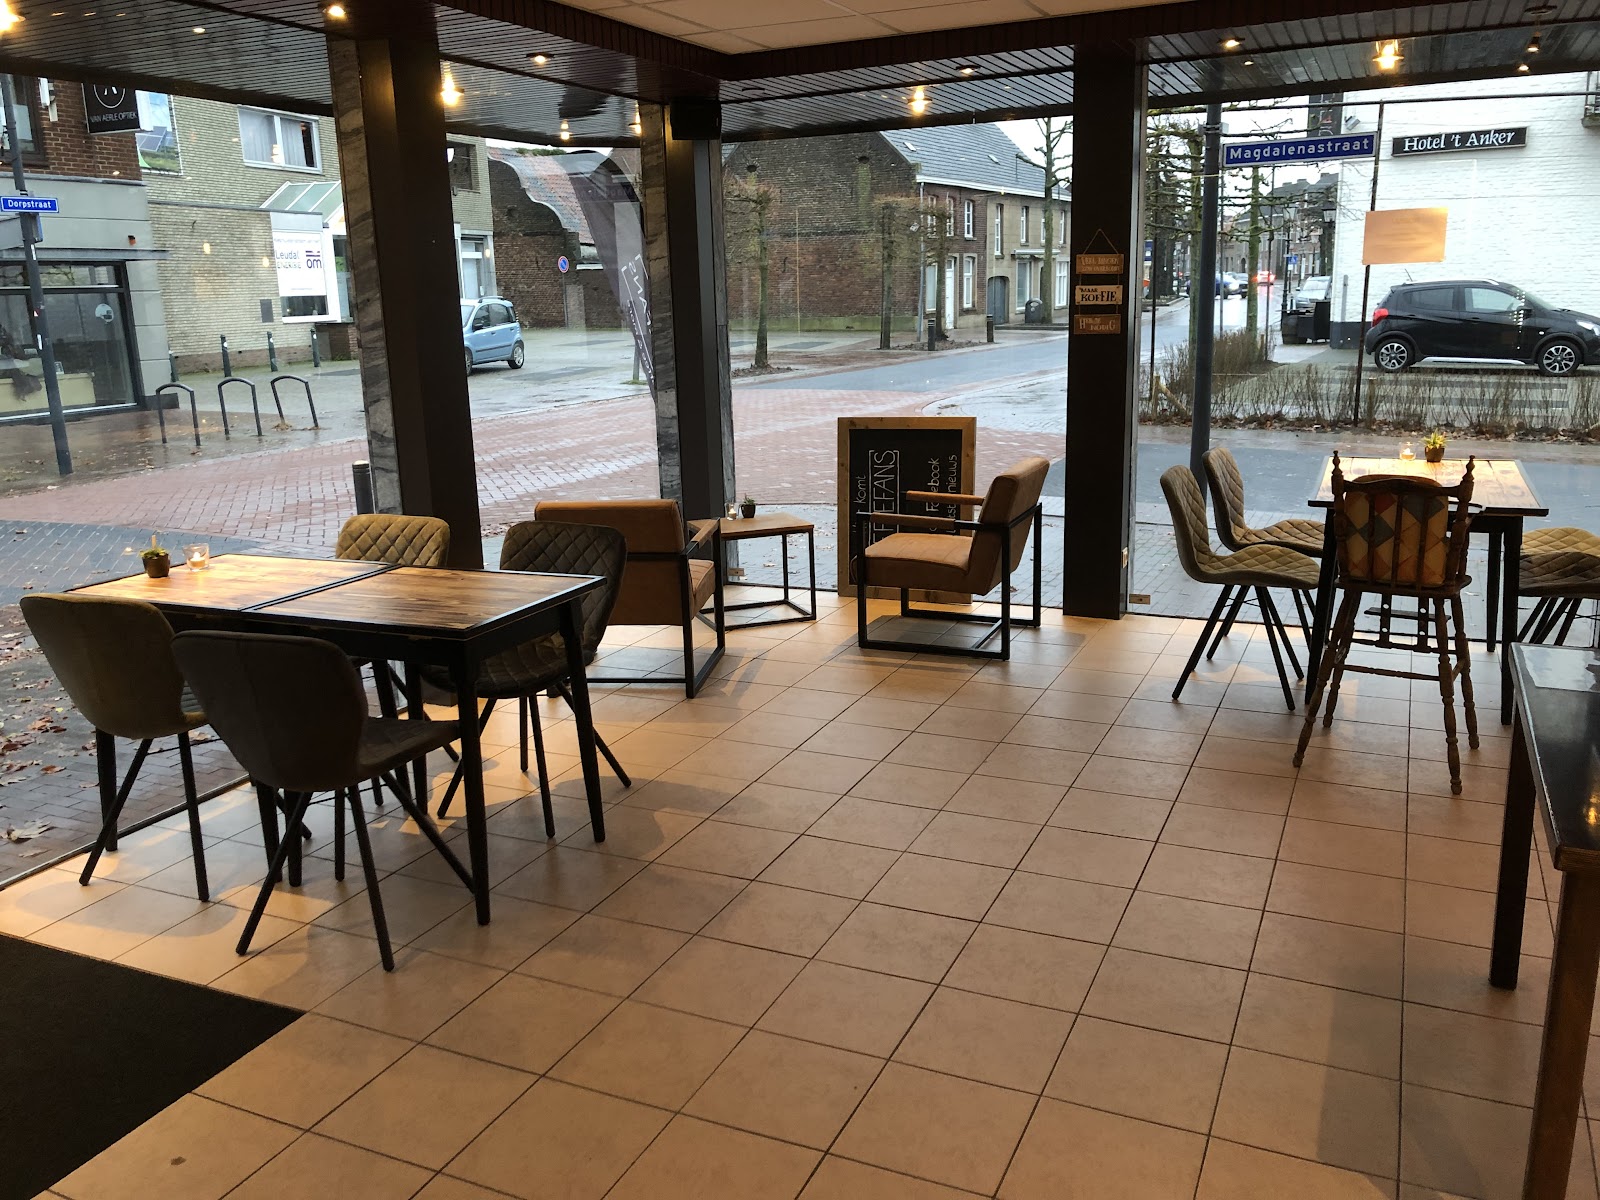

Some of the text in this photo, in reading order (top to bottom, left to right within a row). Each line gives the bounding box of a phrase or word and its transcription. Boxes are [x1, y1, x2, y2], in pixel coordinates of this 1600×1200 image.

[1229, 137, 1370, 161] Magdalenastraat
[1403, 129, 1516, 152] Hotel 't Anker
[7, 199, 52, 209] Dorpstraat
[276, 250, 300, 259] Leudal
[1081, 291, 1117, 302] KOFFIE
[945, 454, 958, 493] nieuws
[853, 475, 866, 504] komt
